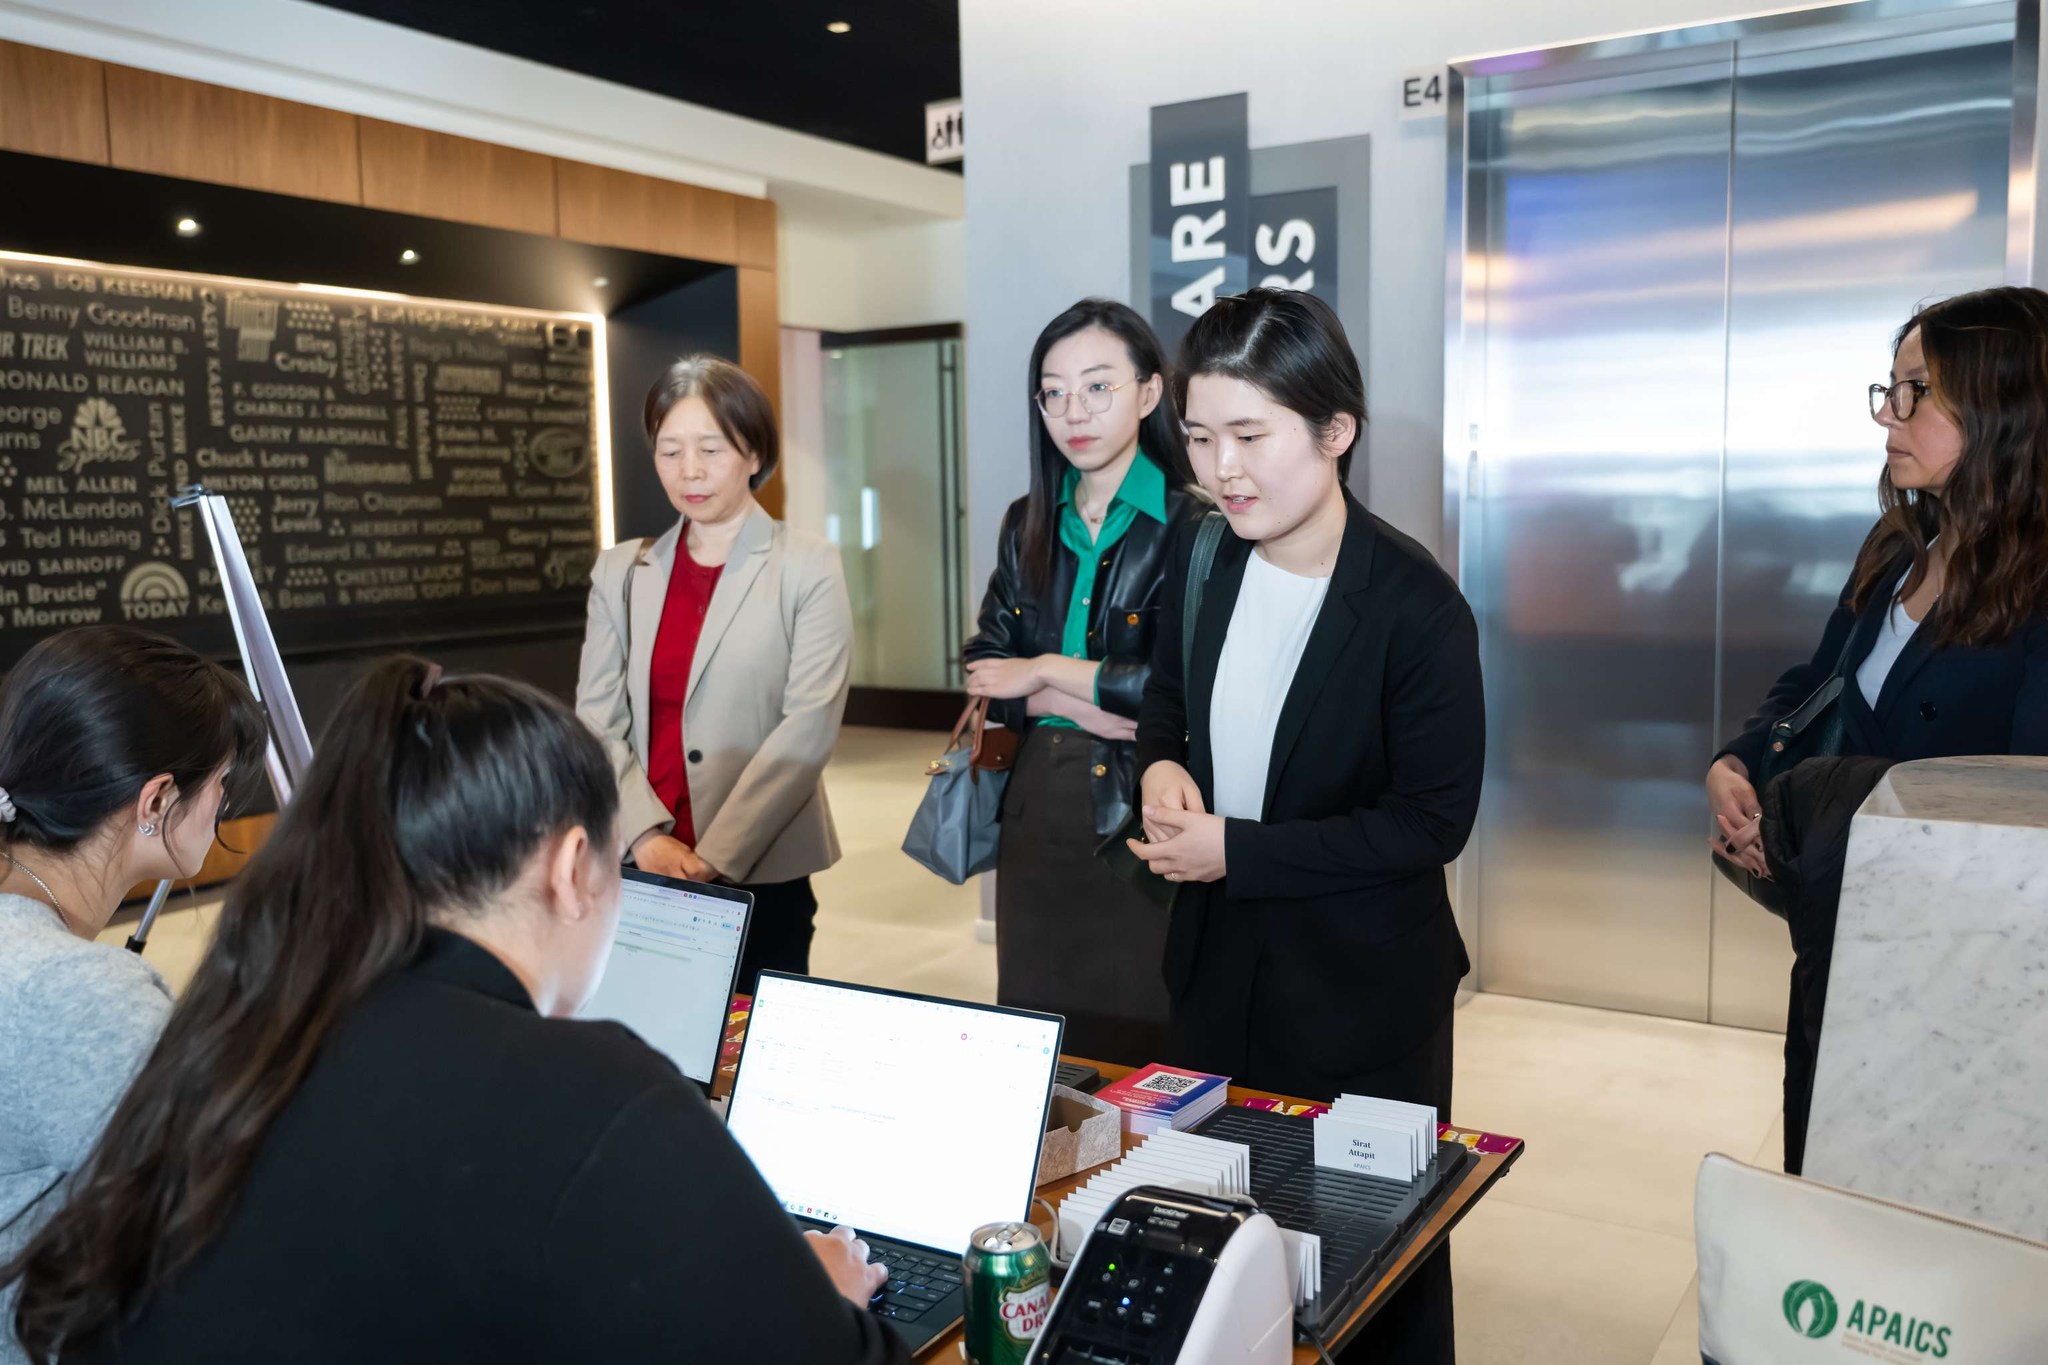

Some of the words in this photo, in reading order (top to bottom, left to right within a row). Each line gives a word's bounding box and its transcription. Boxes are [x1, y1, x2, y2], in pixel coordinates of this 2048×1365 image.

[1404, 75, 1442, 107] E4
[1170, 156, 1226, 318] ARE
[53, 272, 97, 293] BOB
[103, 277, 194, 301] KEESHAN
[8, 296, 80, 328] Benny
[87, 302, 195, 332] Goodman
[200, 287, 220, 351] CASEY
[21, 332, 69, 361] TREK
[83, 331, 167, 350] WILLIAM
[172, 338, 189, 355] B.
[84, 350, 178, 371] WILLIAMS
[275, 351, 338, 379] Crosby
[97, 375, 185, 396] REAGAN
[206, 357, 225, 427] KASEM
[70, 427, 127, 451] NBC
[147, 403, 166, 476] Purtan
[170, 403, 187, 454] MIKE
[230, 424, 293, 443] GARRY
[298, 426, 389, 446] MARSHALL
[196, 449, 256, 468] Chuck
[260, 451, 309, 469] Lorre
[25, 476, 69, 494] MEL
[75, 476, 138, 493] ALLEN
[268, 474, 319, 491] CROSS
[23, 497, 144, 521] McLendon
[148, 484, 171, 534] Dick
[272, 494, 320, 518] Jerry
[19, 528, 61, 549] Ted
[69, 527, 141, 552] Husing
[178, 510, 195, 560] MIKE
[38, 555, 126, 577] SARNOFF
[13, 606, 102, 627] Morrow
[121, 600, 190, 620] TODAY
[1348, 1148, 1375, 1159] Attapit
[1352, 1139, 1371, 1149] Sirat
[1846, 1299, 1952, 1358] APAICS
